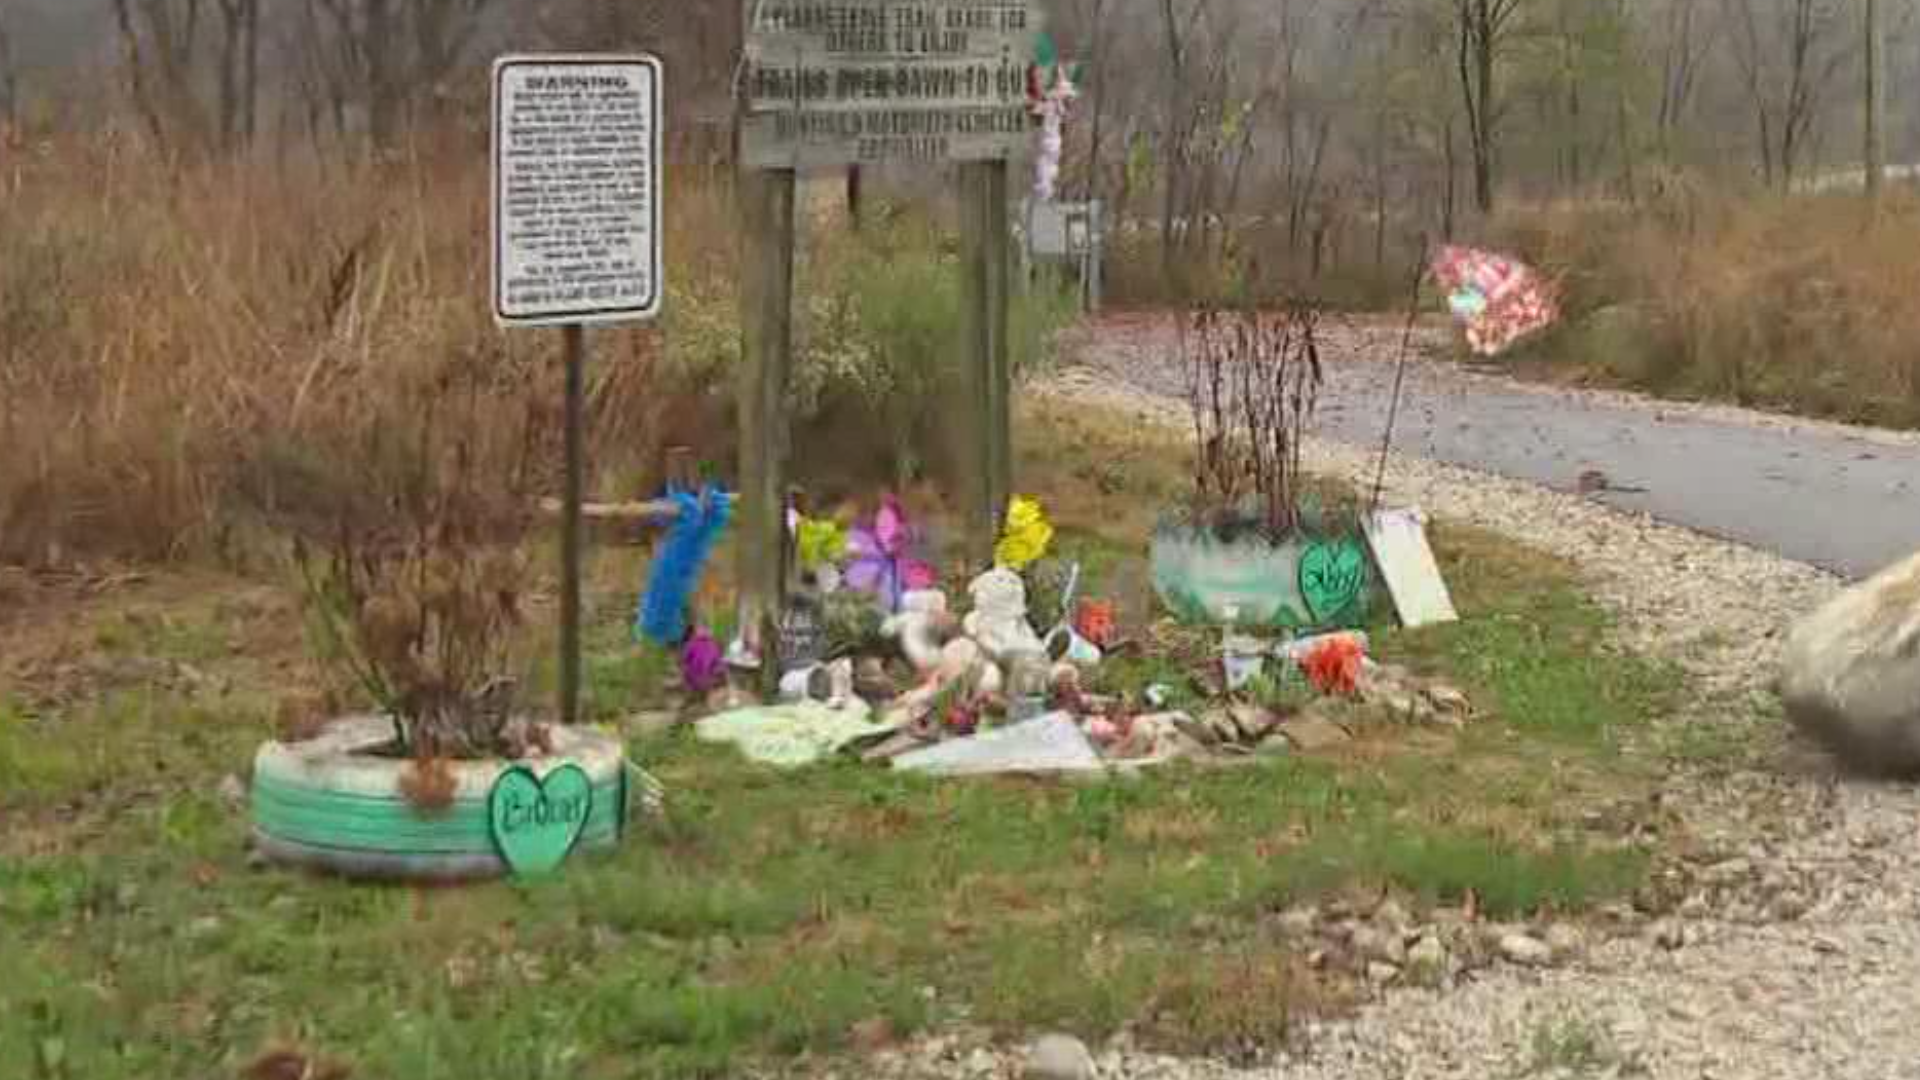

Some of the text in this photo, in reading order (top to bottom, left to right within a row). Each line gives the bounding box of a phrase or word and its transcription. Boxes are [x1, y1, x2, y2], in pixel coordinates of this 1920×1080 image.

[526, 76, 629, 90] WARNING
[895, 66, 957, 97] DAWN
[963, 65, 989, 96] TO
